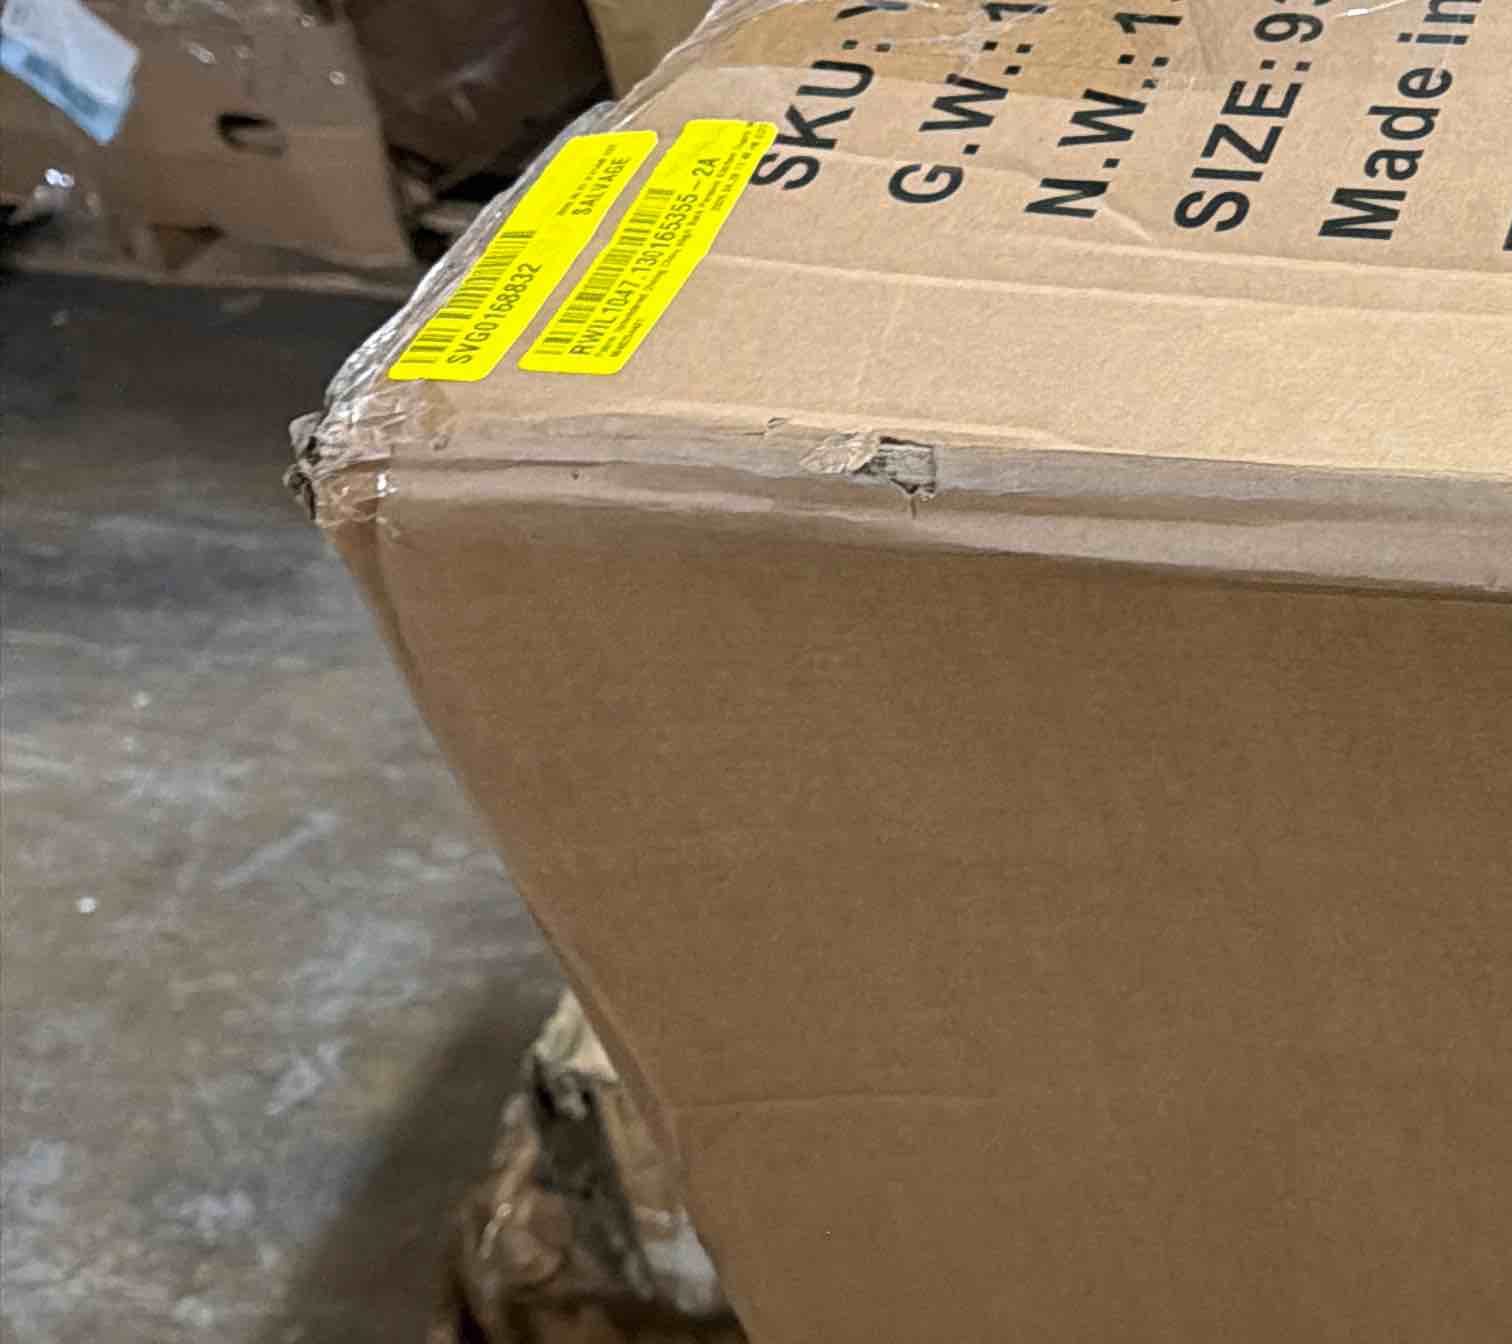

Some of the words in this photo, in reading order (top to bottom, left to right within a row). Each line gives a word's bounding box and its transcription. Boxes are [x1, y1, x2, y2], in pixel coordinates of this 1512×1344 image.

[571, 157, 632, 217] SALVAGE
[1317, 66, 1454, 241] Made
[445, 262, 543, 365] SVG0168832
